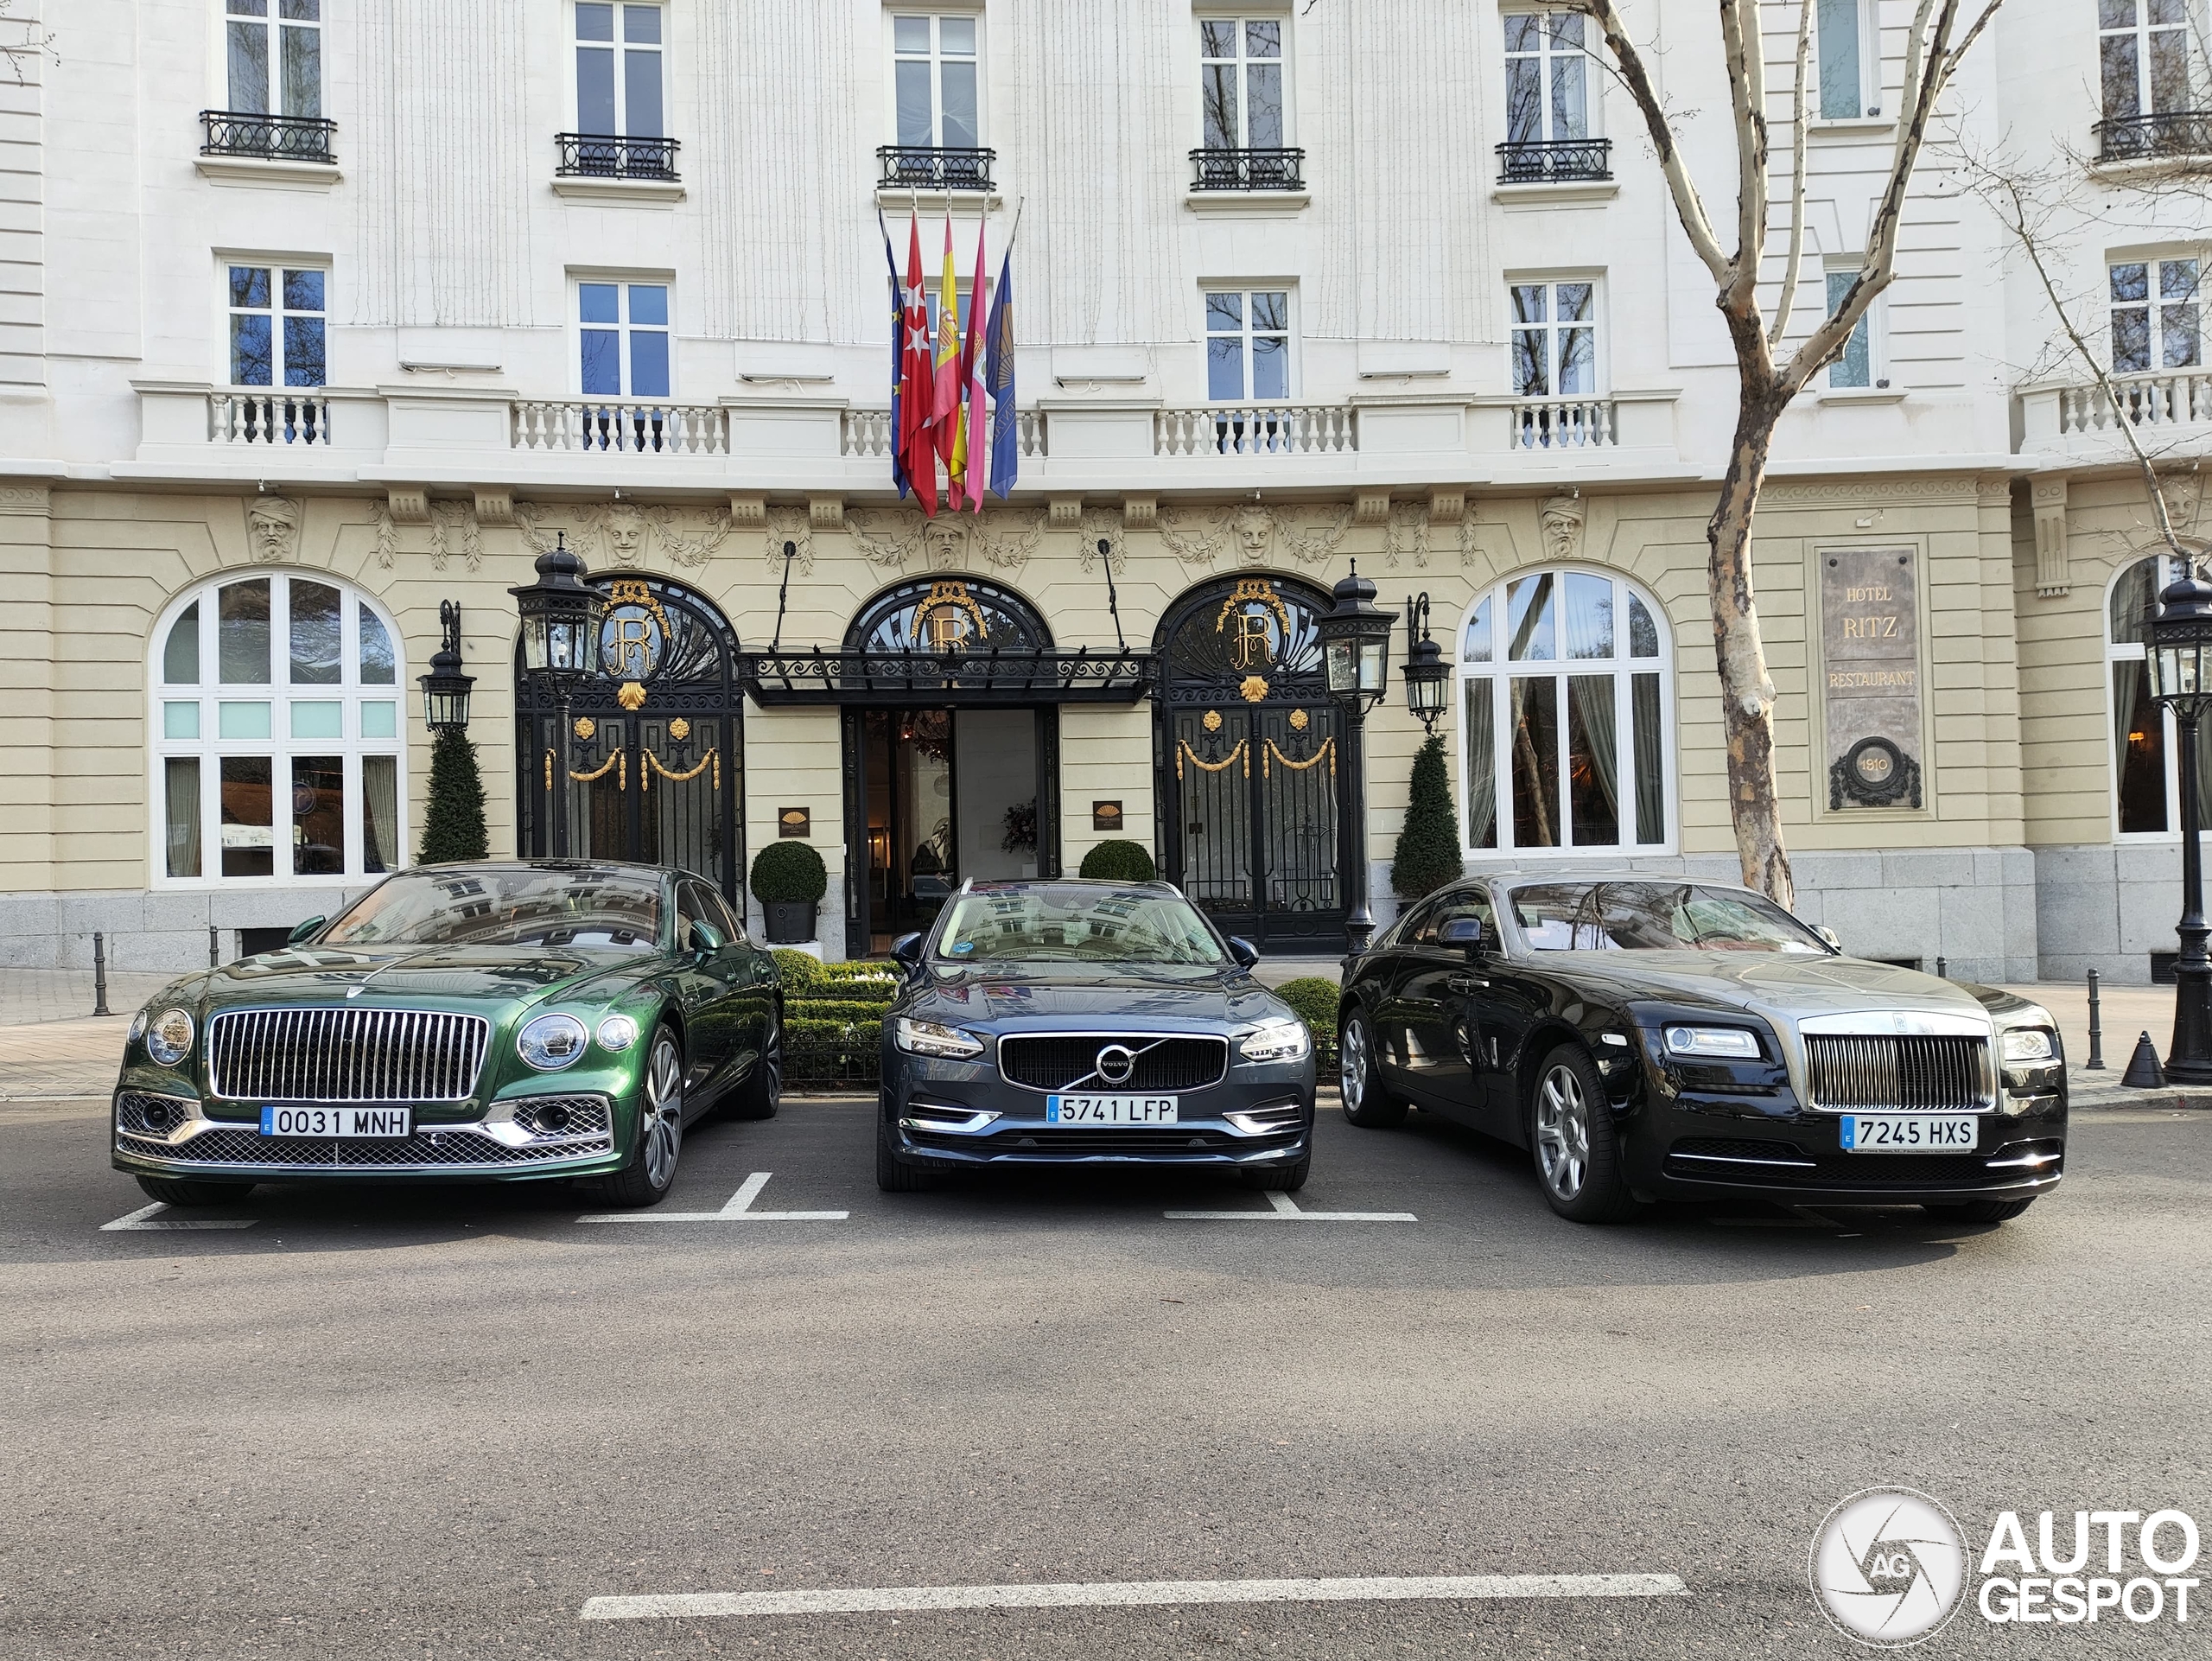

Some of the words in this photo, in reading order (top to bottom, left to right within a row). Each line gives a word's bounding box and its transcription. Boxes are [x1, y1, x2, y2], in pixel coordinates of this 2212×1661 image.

[1847, 587, 1892, 601] HOTEL
[1843, 616, 1897, 639] RITZ
[1829, 671, 1915, 688] RESTAURANT
[1860, 758, 1888, 771] 1910
[1063, 1099, 1117, 1121] 5741
[1130, 1100, 1172, 1121] LFP
[278, 1111, 340, 1134] 0031
[354, 1111, 404, 1135] MNH
[1860, 1122, 1921, 1144] 7245
[1929, 1122, 1971, 1144] HXS
